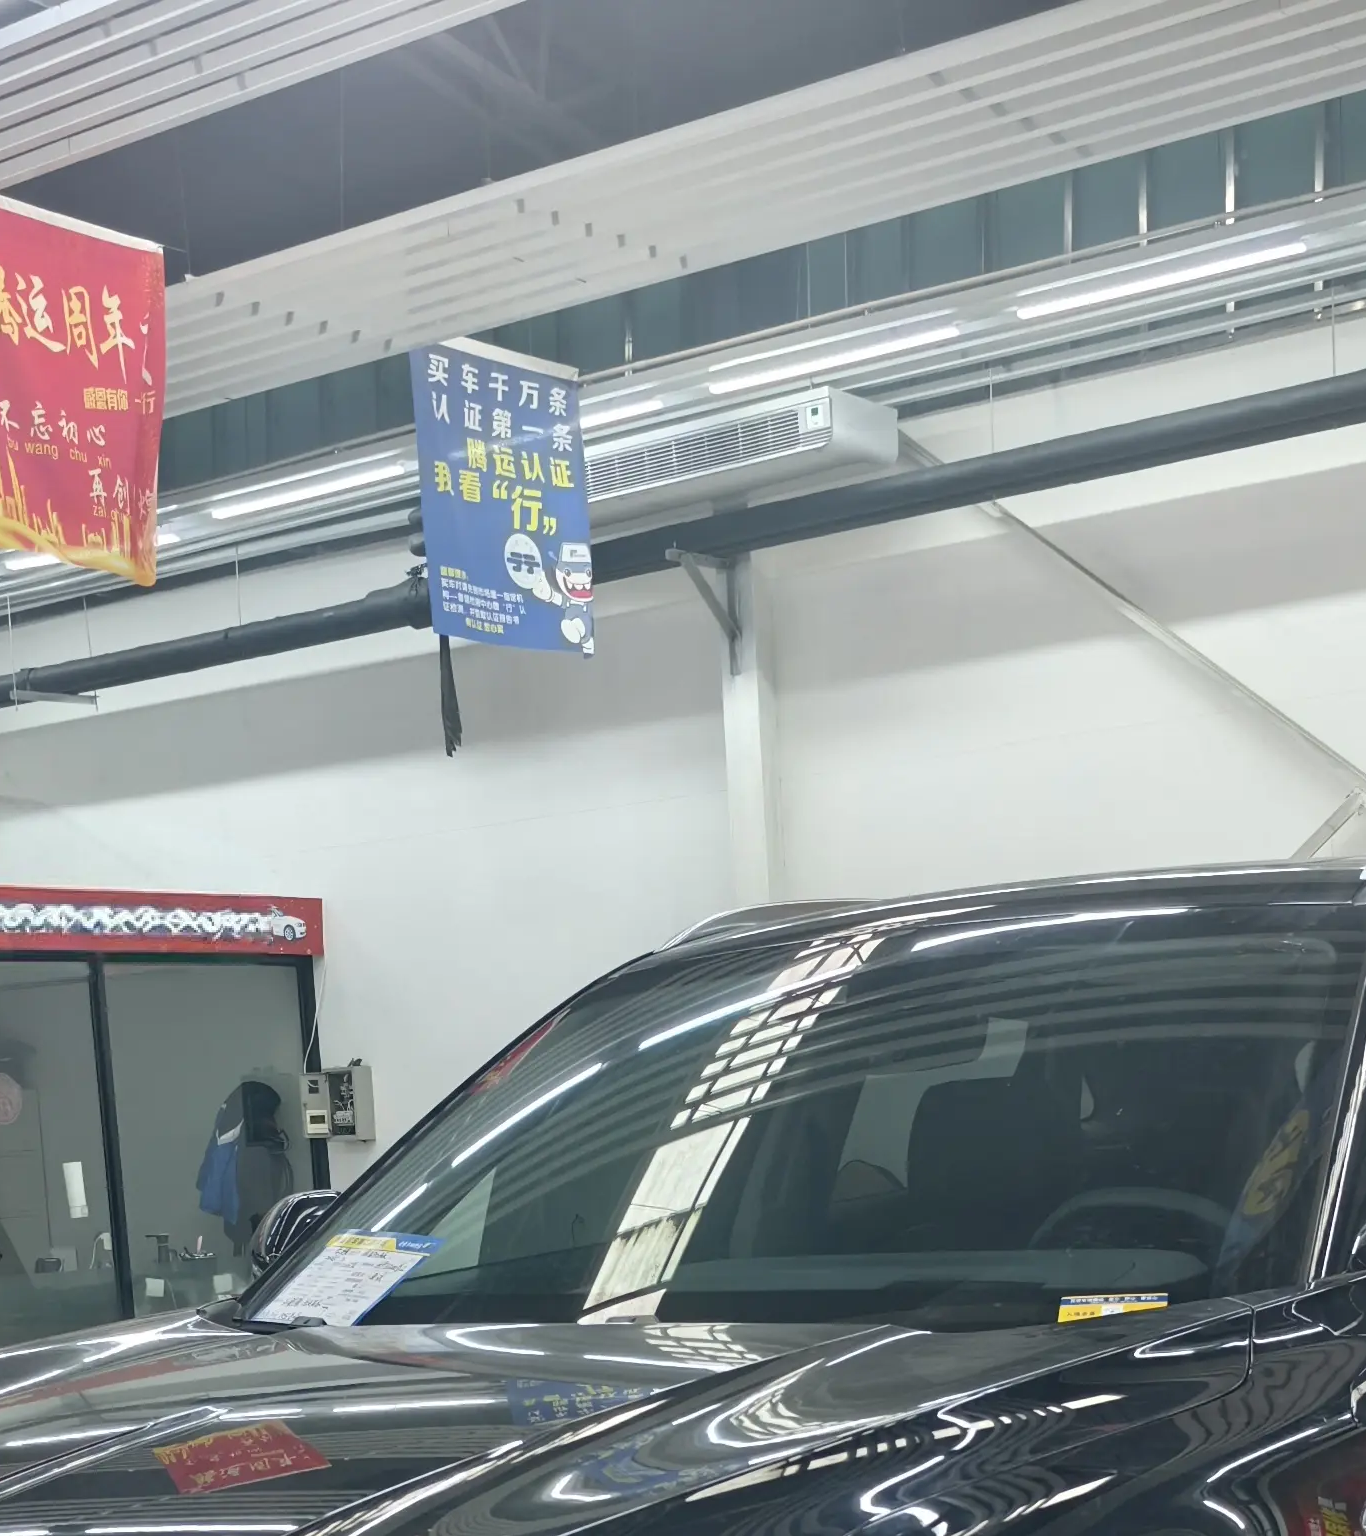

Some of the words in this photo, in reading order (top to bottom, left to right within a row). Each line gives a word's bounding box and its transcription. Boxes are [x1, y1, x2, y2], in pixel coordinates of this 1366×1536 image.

[427, 354, 568, 417] 买车千万条
[432, 392, 573, 452] 认证第一条
[24, 441, 59, 460] wang
[69, 447, 87, 463] chu
[466, 437, 575, 489] 腾运认证
